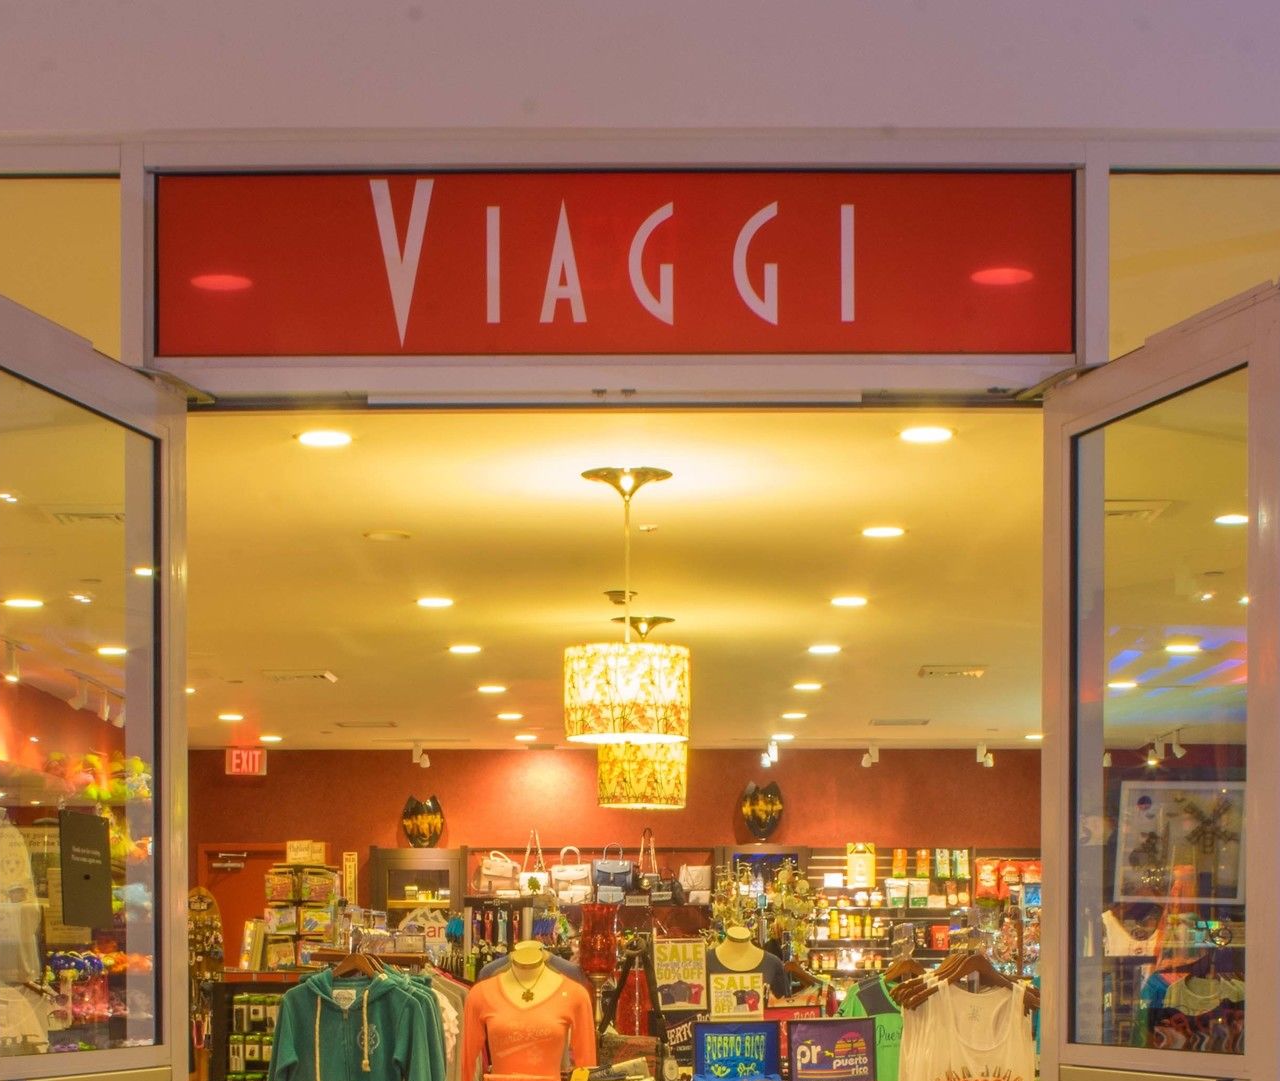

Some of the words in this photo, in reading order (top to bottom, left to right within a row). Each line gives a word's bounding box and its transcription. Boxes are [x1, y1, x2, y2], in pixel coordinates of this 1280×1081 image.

[368, 178, 856, 349] VIAGGI
[231, 750, 261, 773] EXIT
[656, 944, 701, 961] SALE
[682, 967, 703, 980] OFF
[714, 976, 760, 990] SALE
[705, 1034, 742, 1061] PUERTO
[744, 1034, 766, 1061] RICO
[796, 1044, 821, 1071] pr
[832, 1055, 868, 1070] puerto
[851, 1064, 869, 1076] rico
